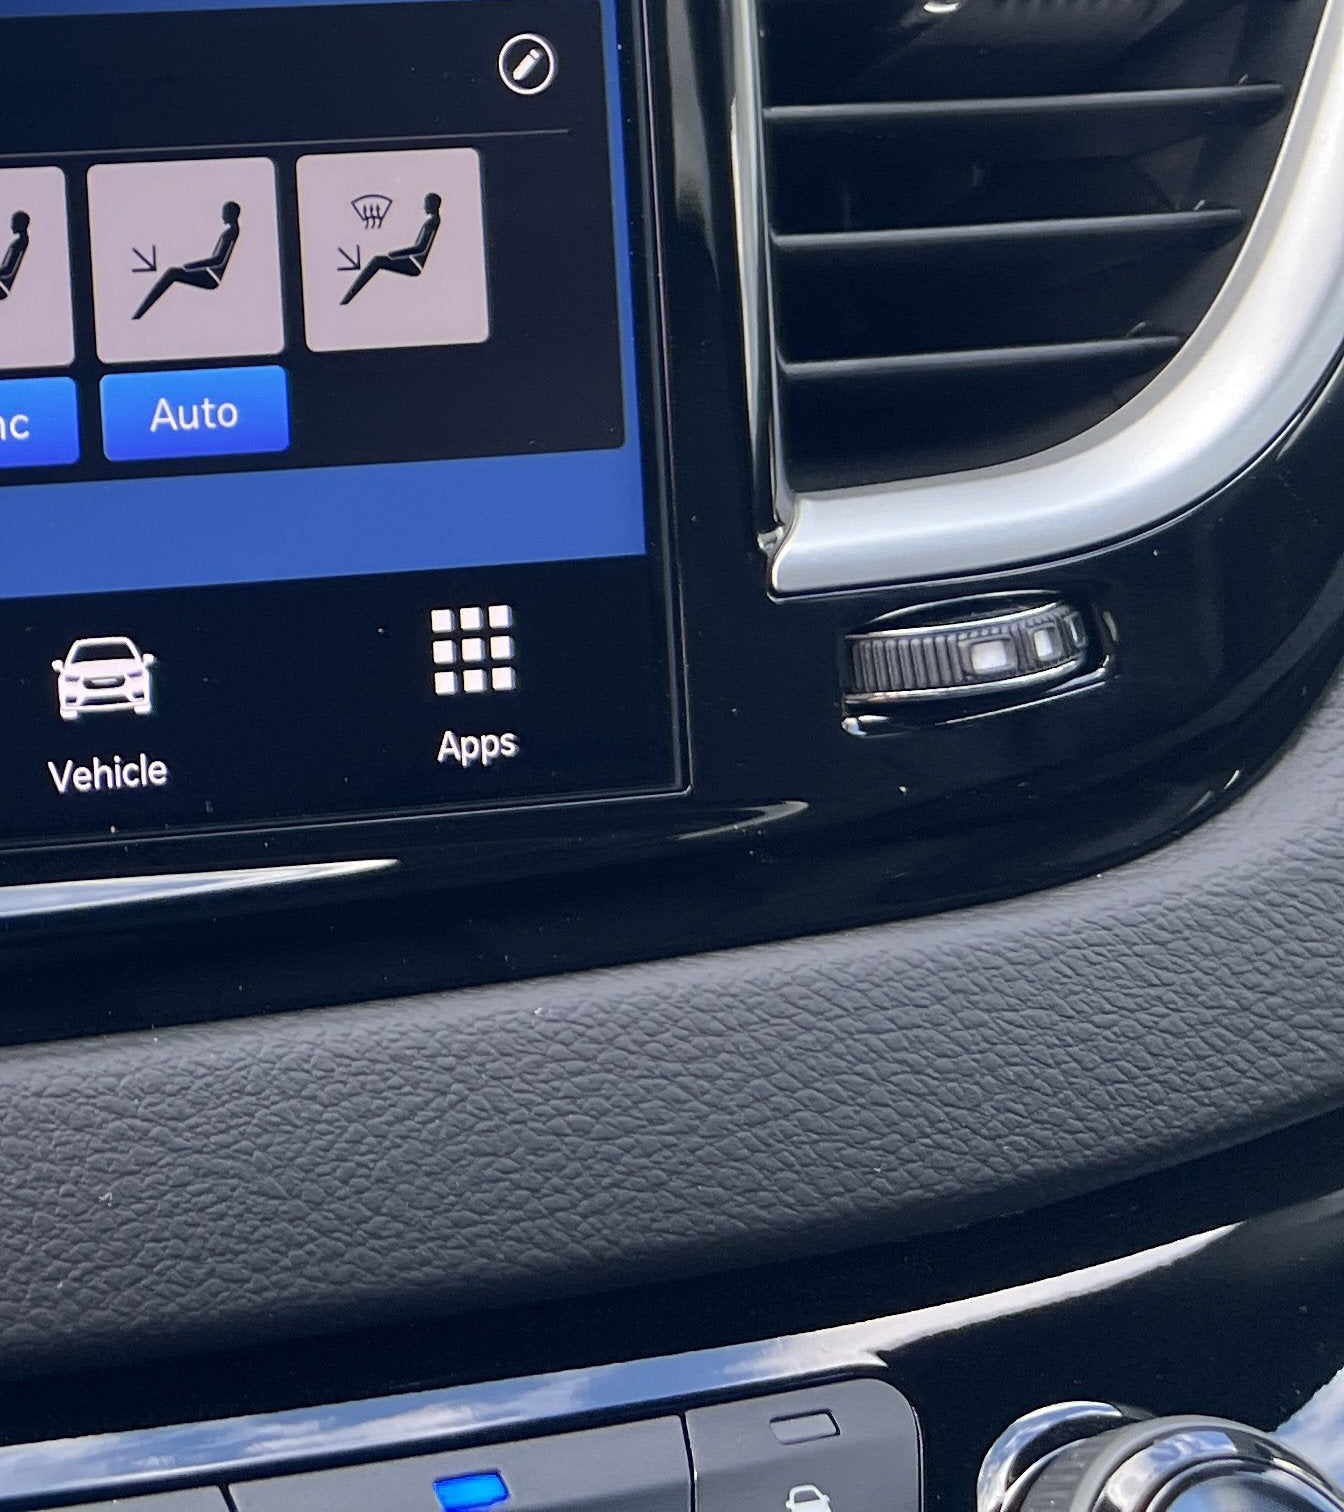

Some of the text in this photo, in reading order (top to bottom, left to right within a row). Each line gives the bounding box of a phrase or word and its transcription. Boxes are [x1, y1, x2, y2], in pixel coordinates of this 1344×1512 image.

[149, 397, 238, 432] Auto
[437, 730, 518, 767] Apps
[47, 753, 168, 793] Vehicle
